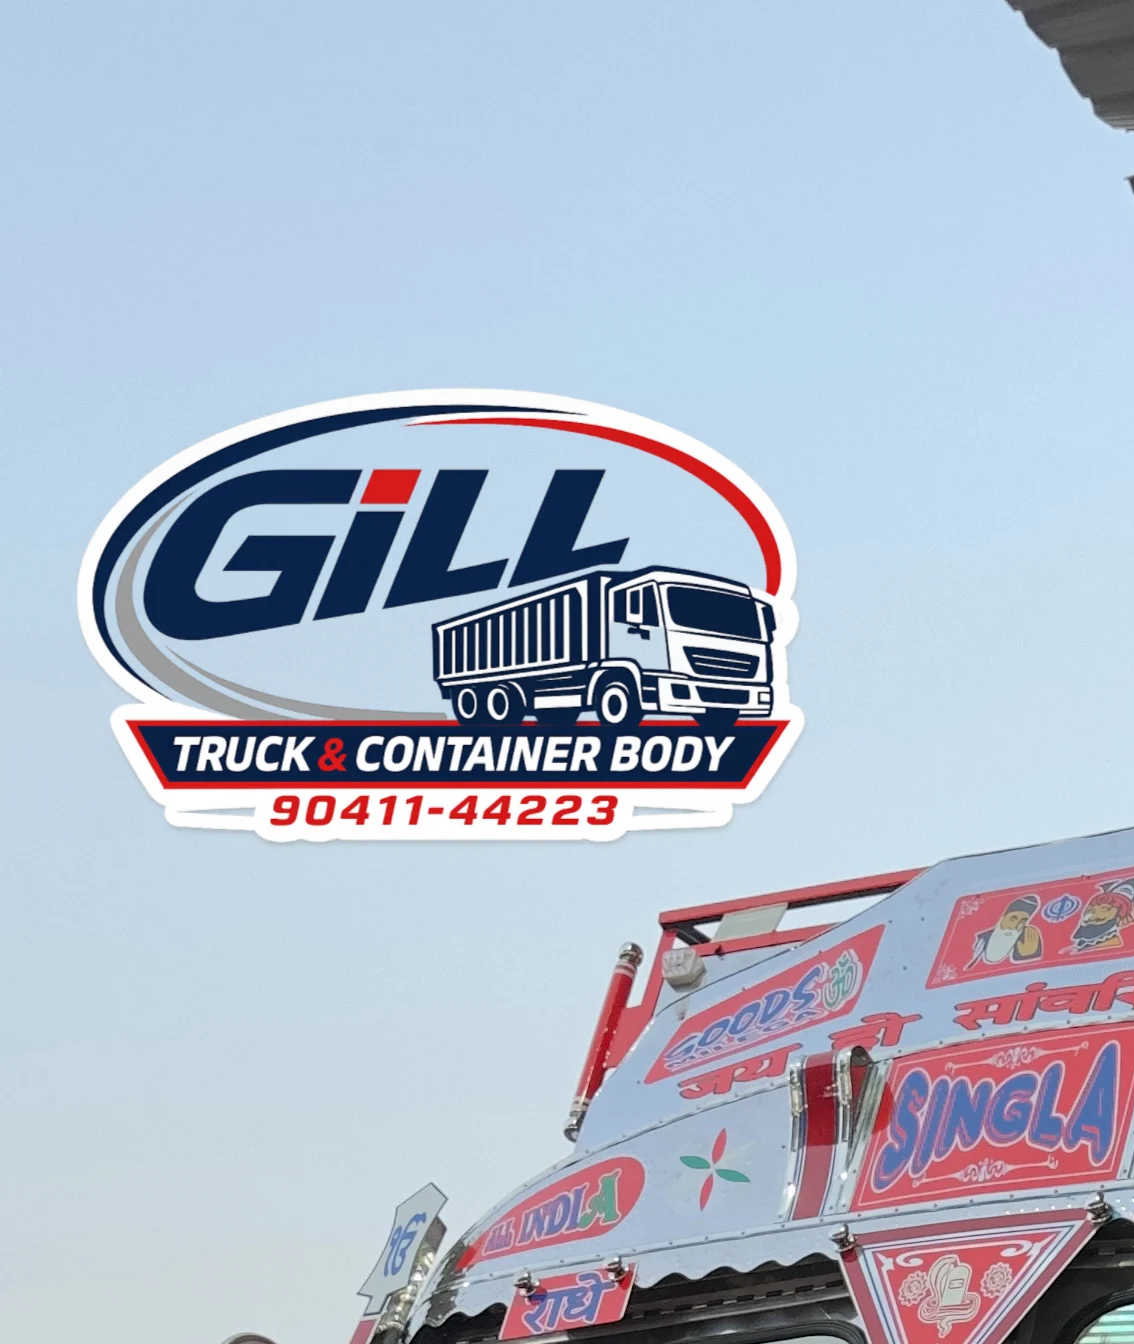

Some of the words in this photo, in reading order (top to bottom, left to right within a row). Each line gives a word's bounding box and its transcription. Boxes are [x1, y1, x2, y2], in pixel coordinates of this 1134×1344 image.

[665, 964, 828, 1060] GOODS
[677, 1042, 803, 1100] जय
[871, 1039, 1121, 1192] SINGLA
[516, 1168, 622, 1246] INDIA
[522, 1269, 618, 1334] राधे
